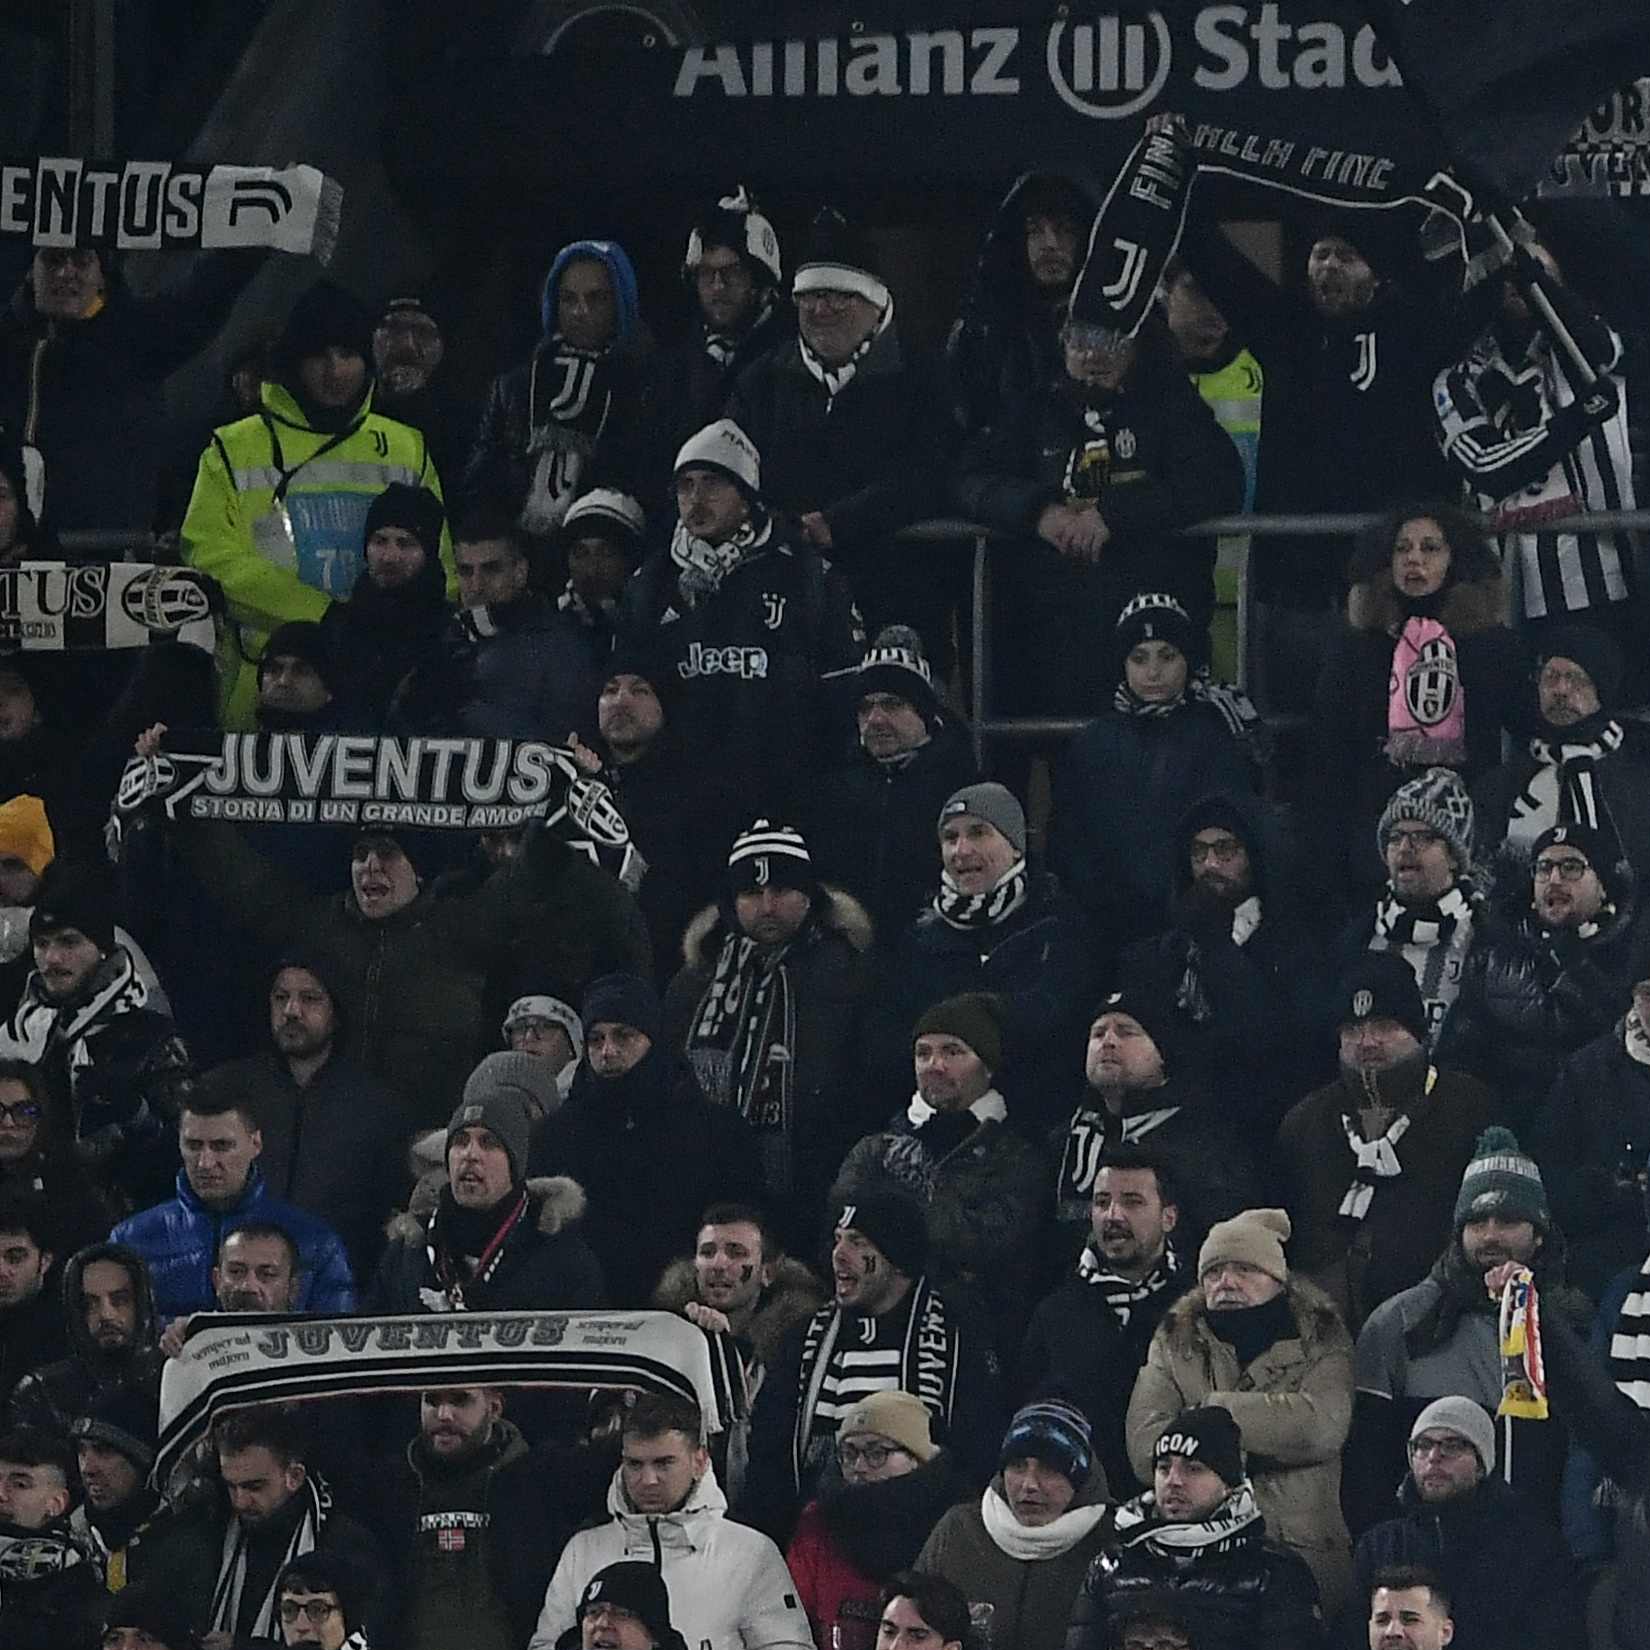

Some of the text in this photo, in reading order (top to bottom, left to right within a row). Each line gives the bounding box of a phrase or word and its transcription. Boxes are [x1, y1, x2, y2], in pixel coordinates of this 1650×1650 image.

[673, 27, 1020, 98] Allianz
[677, 640, 768, 679] Jeep
[205, 732, 553, 804] JUVENTUS
[191, 795, 284, 822] STORIA
[288, 797, 316, 822] DI
[321, 798, 358, 823] UN
[362, 799, 467, 826] GRANDE
[257, 1317, 572, 1362] JUVENTUS
